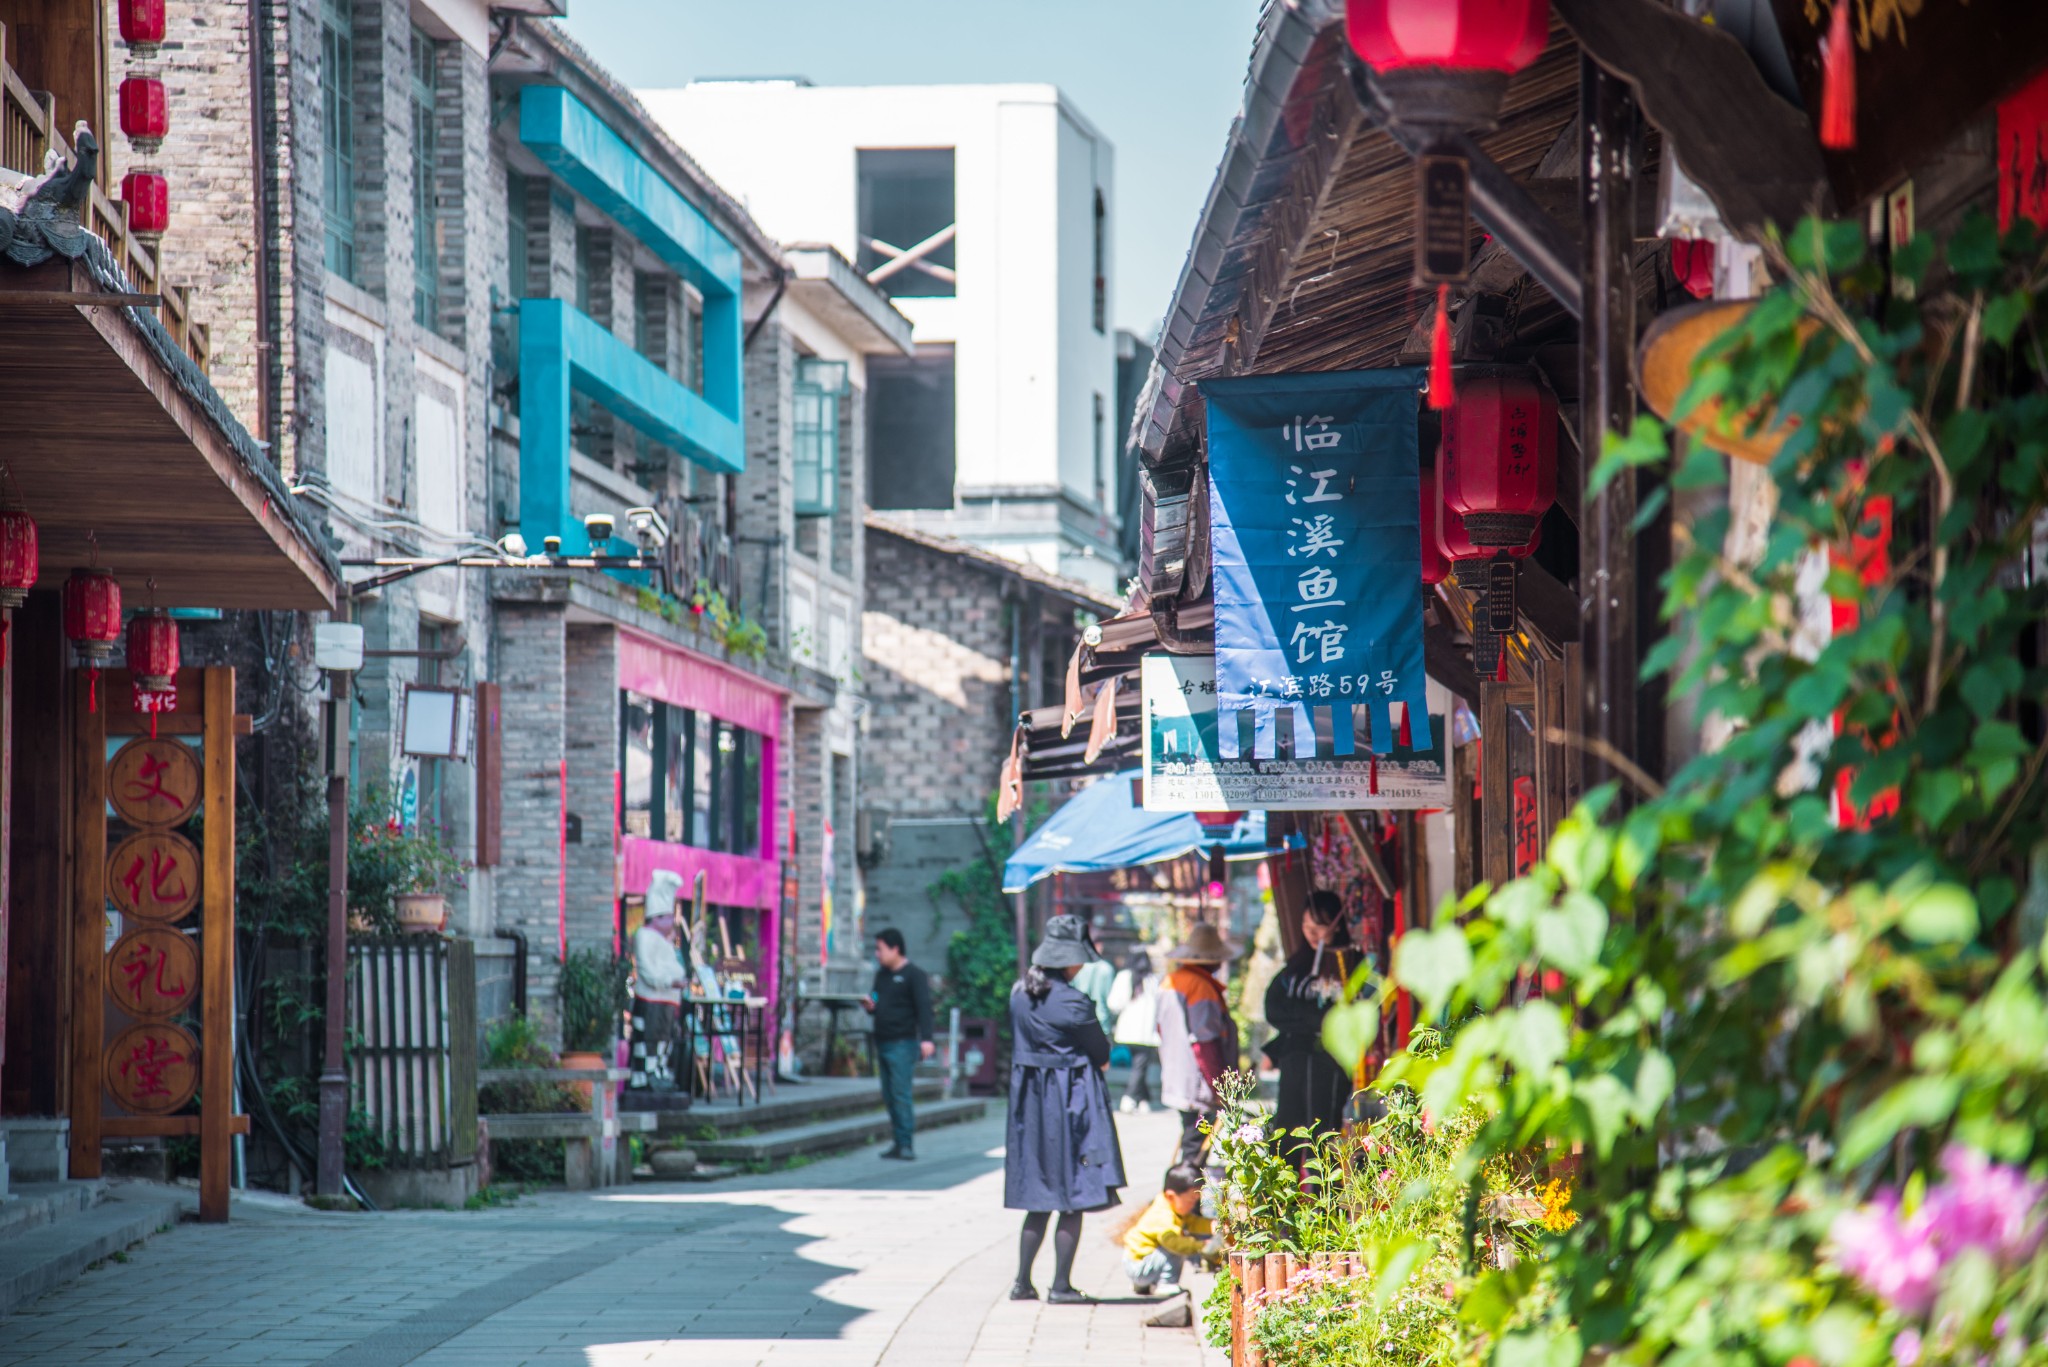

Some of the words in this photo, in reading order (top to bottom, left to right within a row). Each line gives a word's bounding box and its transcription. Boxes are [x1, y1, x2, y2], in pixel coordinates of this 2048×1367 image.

[1283, 414, 1349, 664] 临江溪鱼馆
[1250, 669, 1399, 700] 江滨路59号
[1366, 789, 1422, 799] 1587161935
[123, 752, 185, 1097] 文化礼堂
